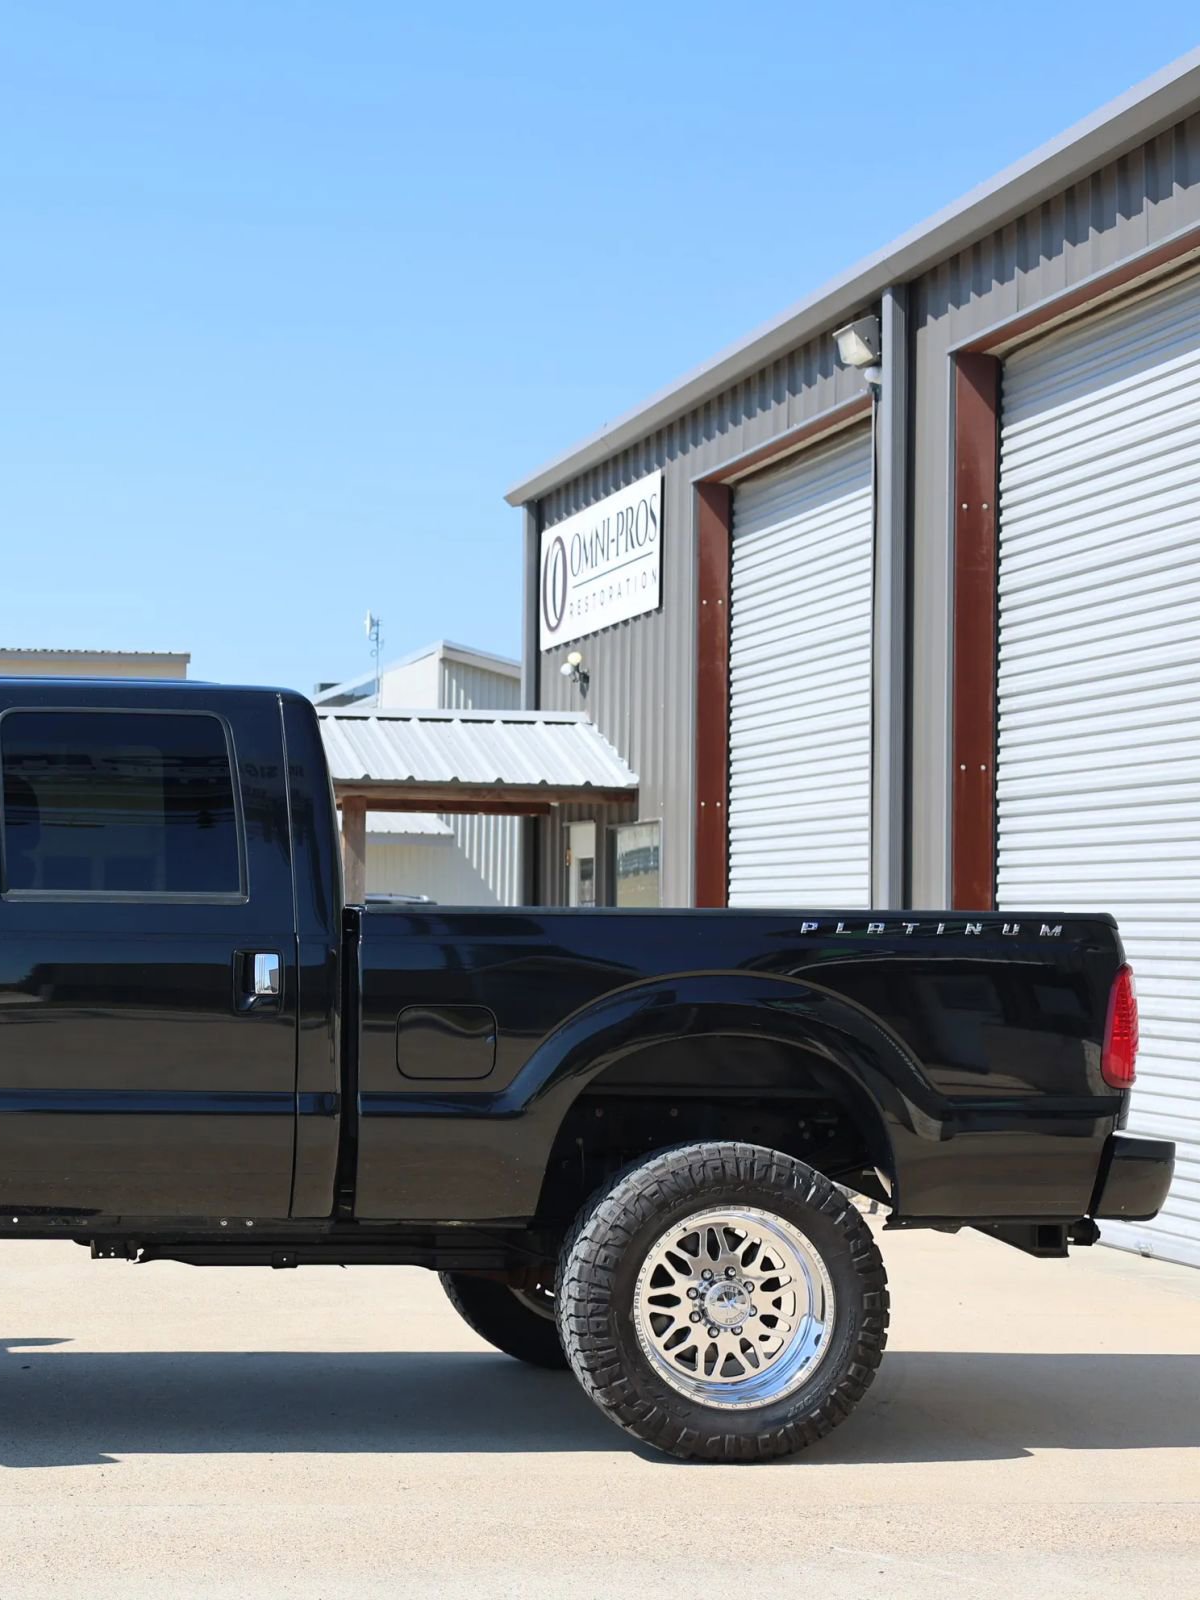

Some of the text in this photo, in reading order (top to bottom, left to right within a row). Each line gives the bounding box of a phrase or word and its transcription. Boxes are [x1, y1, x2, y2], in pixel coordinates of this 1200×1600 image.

[570, 493, 658, 577] OMNI-PROS
[569, 567, 658, 618] RESTORATION
[800, 922, 1063, 937] PLATINUM
